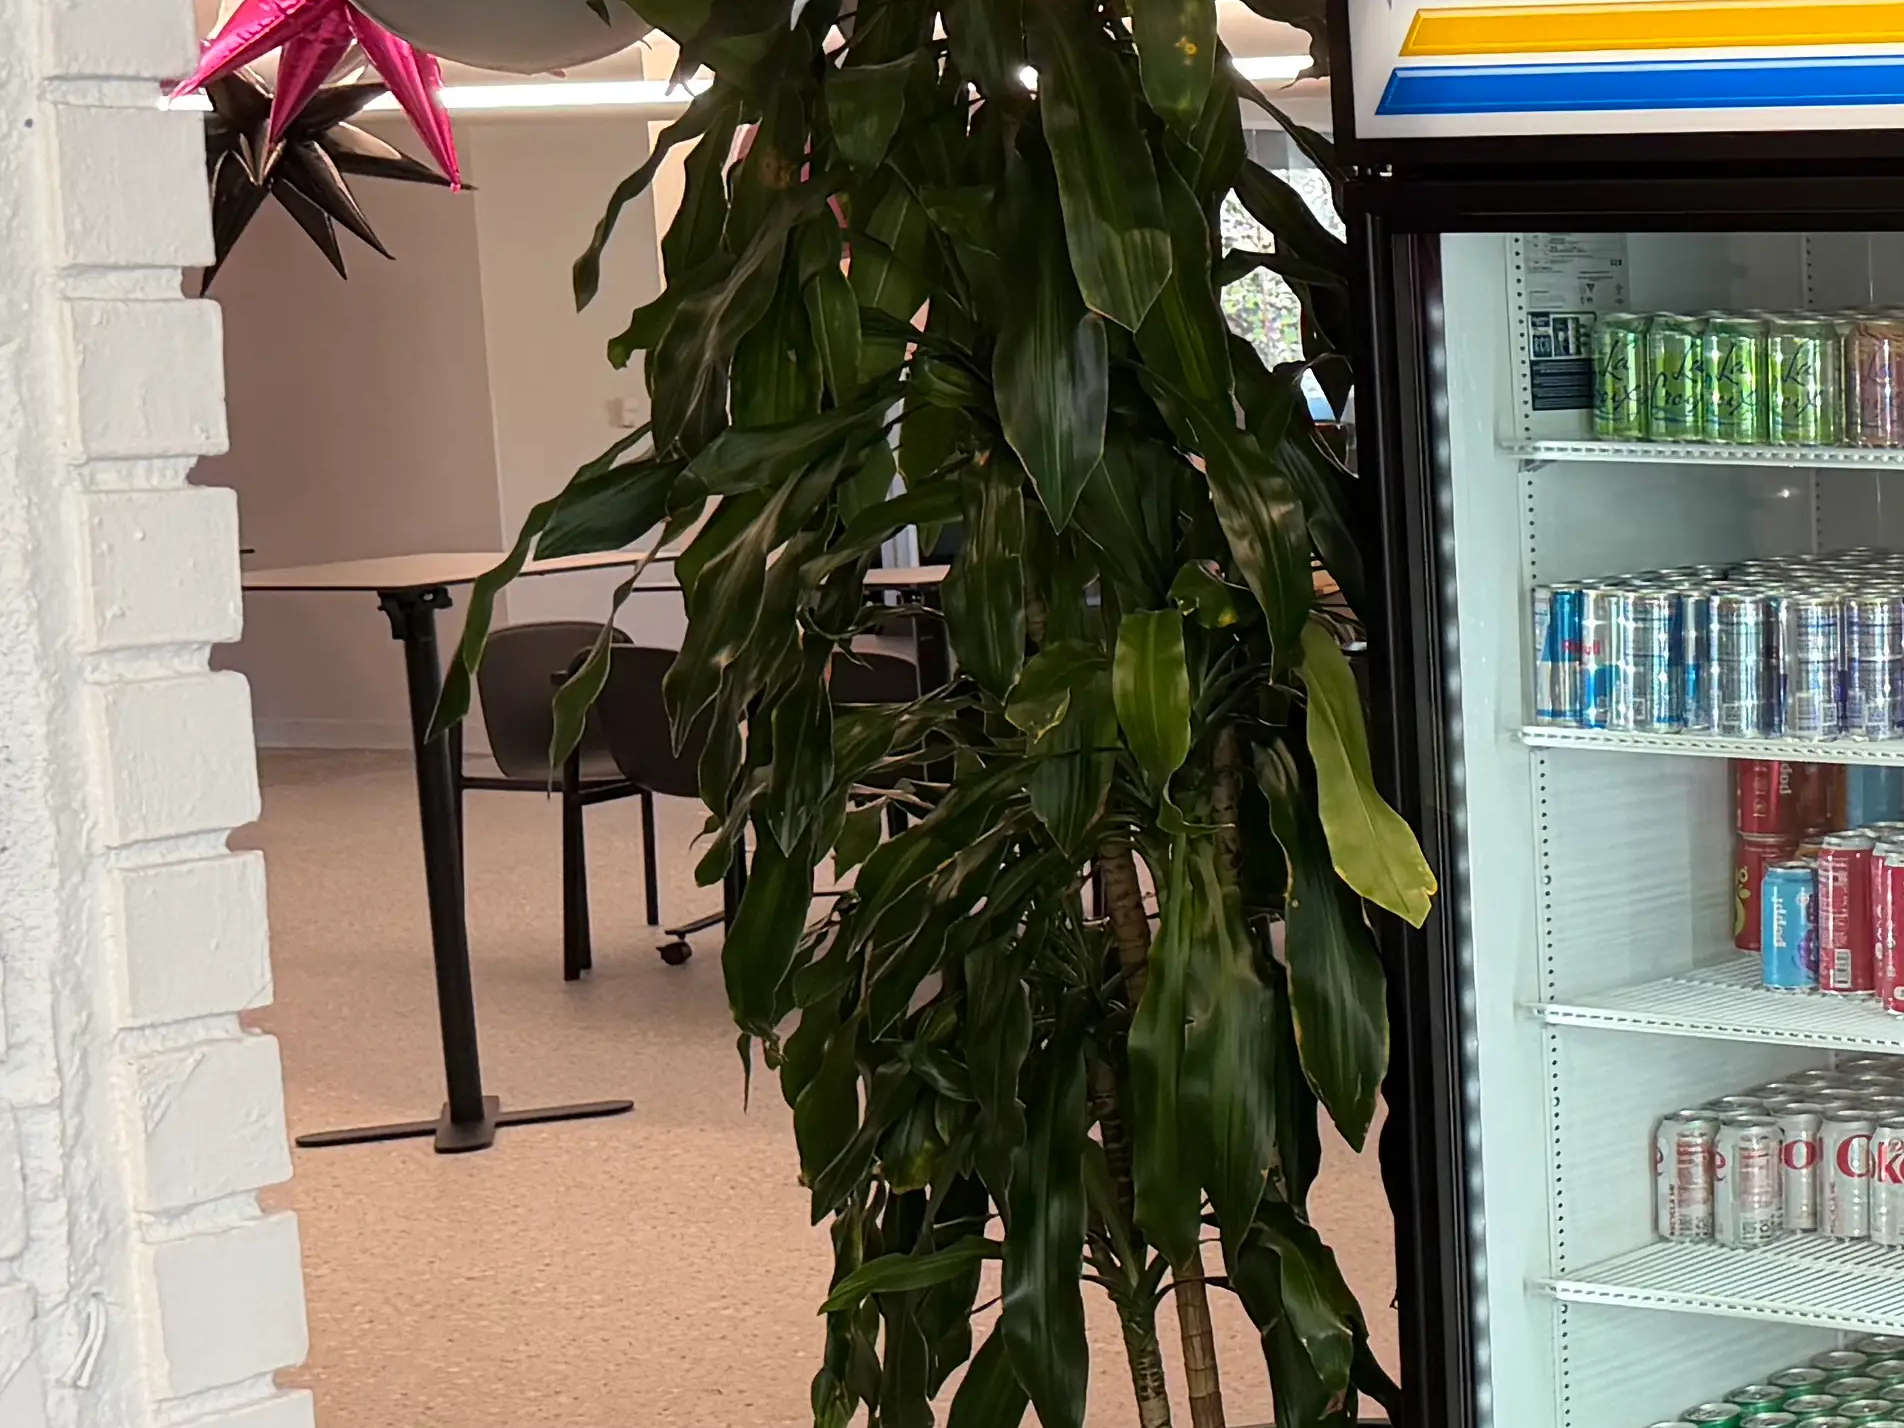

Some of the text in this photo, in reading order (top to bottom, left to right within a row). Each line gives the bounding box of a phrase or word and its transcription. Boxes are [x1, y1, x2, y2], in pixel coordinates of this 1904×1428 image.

[1603, 339, 1630, 382] La
[1717, 341, 1744, 385] La
[1782, 342, 1811, 387] La
